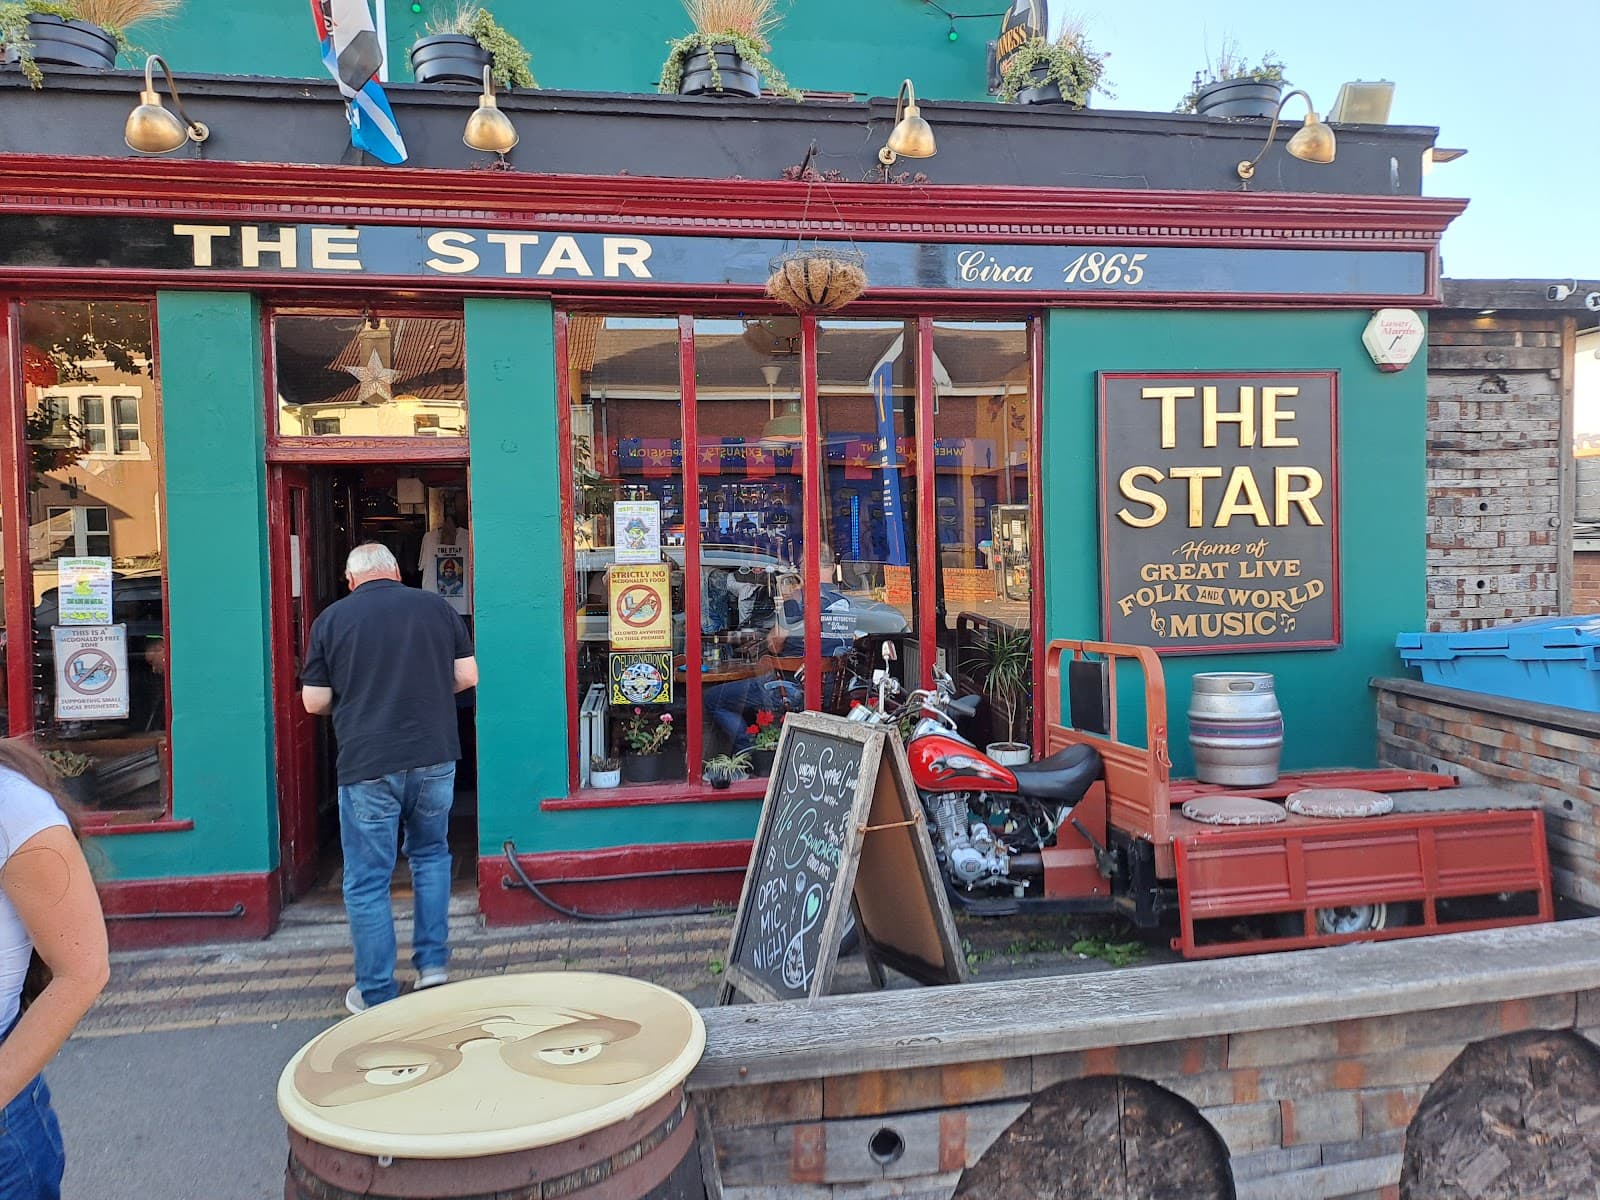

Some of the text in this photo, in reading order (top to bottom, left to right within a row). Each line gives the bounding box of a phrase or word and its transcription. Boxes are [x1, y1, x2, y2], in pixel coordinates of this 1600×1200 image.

[173, 225, 653, 278] THE STAR
[957, 250, 1148, 285] Circa 1865
[1141, 386, 1300, 449] THE
[1116, 465, 1325, 529] STAR
[1172, 537, 1270, 561] Home of
[611, 570, 665, 579] STRICTLY NO
[1140, 559, 1301, 582] GREAT LIVE
[1117, 579, 1325, 617] FOLK AND WORLD
[1169, 610, 1278, 638] MUSIC
[612, 653, 669, 681] CELTIC NATIONS
[758, 873, 788, 911] OPEN
[760, 903, 782, 937] MIC
[753, 923, 788, 970] NIGHT
